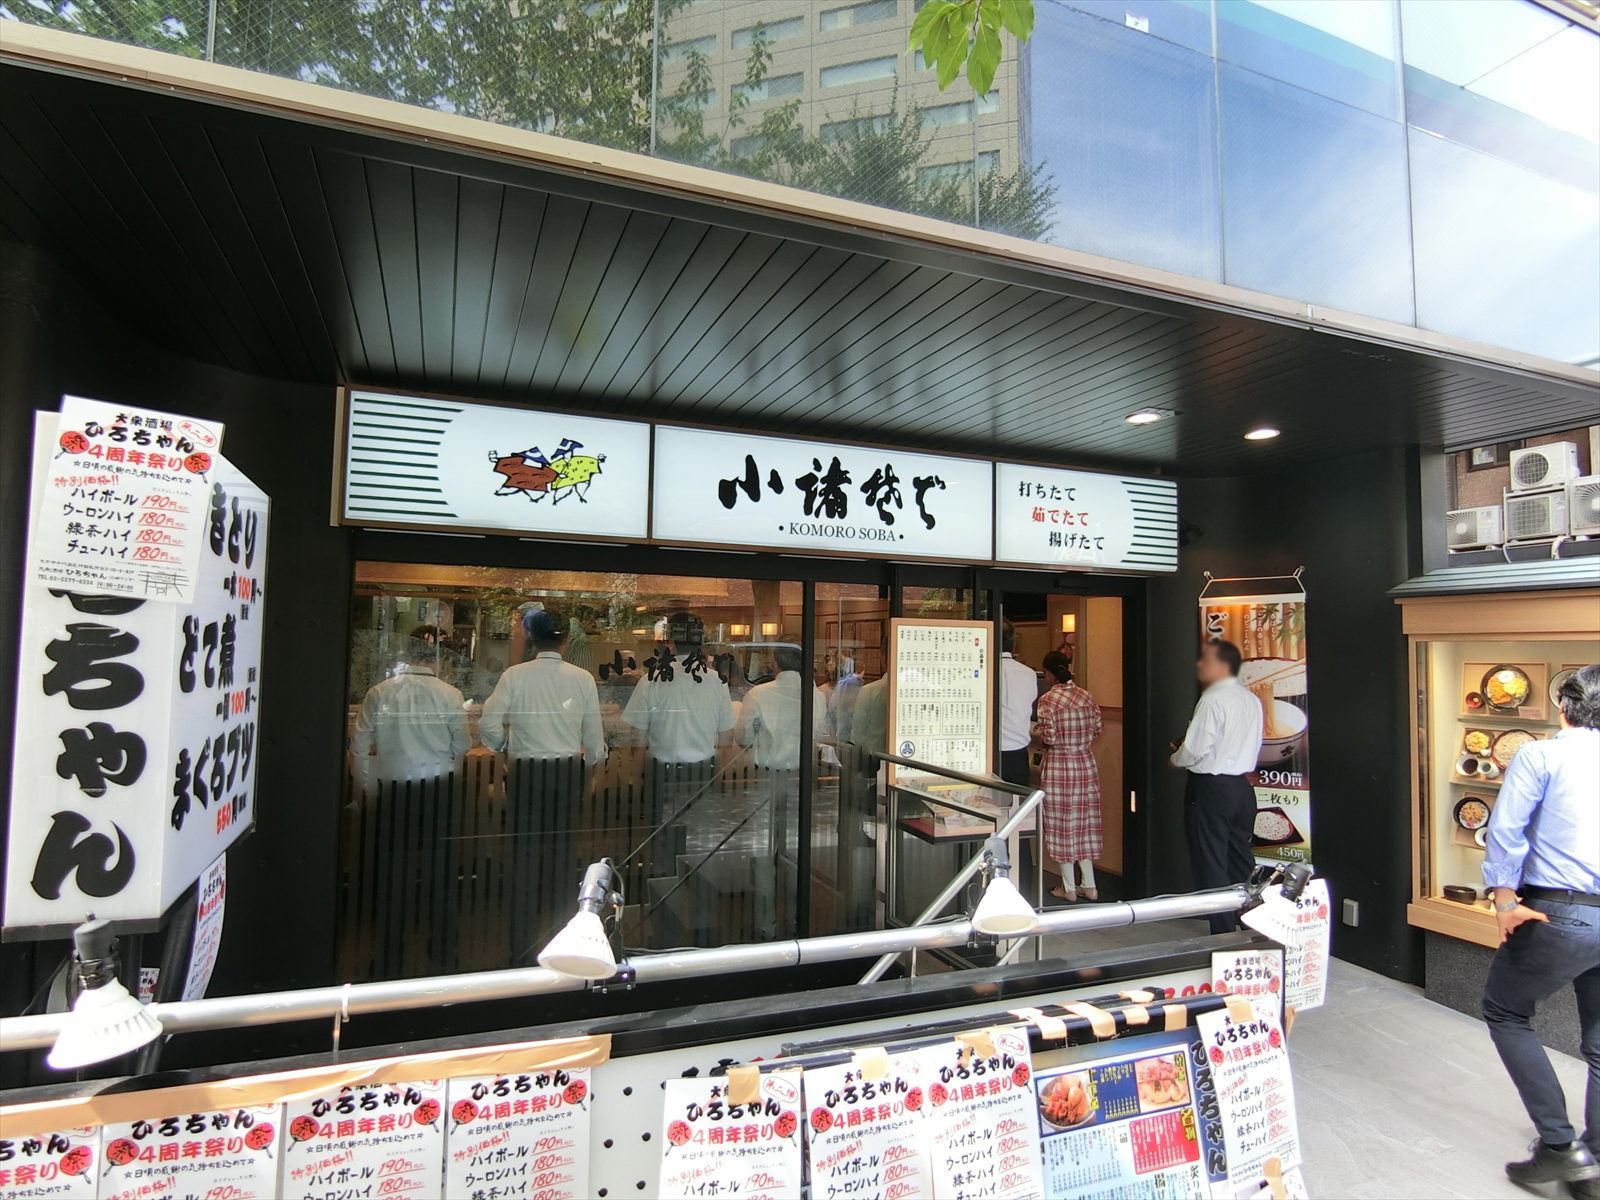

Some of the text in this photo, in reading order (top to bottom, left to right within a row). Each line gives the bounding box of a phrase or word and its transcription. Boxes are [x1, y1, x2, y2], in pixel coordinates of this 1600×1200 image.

[116, 413, 173, 431] 大衆酒場
[85, 422, 195, 454] ひろちゃん
[89, 445, 183, 471] 4周年祭り
[54, 476, 119, 487] 特別価格!!
[1019, 481, 1076, 501] 打ちたて
[71, 487, 138, 505] ハイボール
[142, 496, 176, 509] 190円
[63, 505, 173, 525] ウーロンハイ 180円
[1032, 507, 1088, 526] 茹でたて
[66, 523, 171, 543] 緑茶ハイ 180円
[789, 521, 896, 543] KOMORO SOBA
[1049, 532, 1105, 550] 揚げたて
[67, 540, 168, 560] チューハイ 180円
[180, 613, 237, 693] どて煮
[31, 590, 147, 900] ちゃん
[171, 721, 255, 831] まぐろブツ
[1259, 770, 1302, 786] 390円
[1258, 793, 1299, 806] 二枚もり
[1277, 847, 1304, 858] 450円
[1296, 897, 1320, 909] ちゃん
[1296, 913, 1318, 924] 年祭り
[1224, 967, 1272, 982] ひろちゃん
[1214, 1020, 1269, 1046] ひろちゃん
[1225, 1040, 1270, 1065] 4周年祭り
[939, 1053, 1016, 1083] ひろちゃん
[471, 1070, 571, 1101] ひろちゃん
[824, 1077, 909, 1109] ひろちゃん
[949, 1076, 1013, 1103] 4周年祭り
[1231, 1085, 1261, 1105] ハイボール
[312, 1087, 422, 1117] ひろちゃん
[478, 1093, 563, 1122] 4周年祭り
[687, 1098, 780, 1122] ひろちゃん
[1190, 1040, 1227, 1175] ひろちゃん
[1231, 1101, 1263, 1124] ウーロンハイ
[132, 1109, 255, 1140] ひろちゃん
[319, 1112, 413, 1140] 4周年祭り
[833, 1102, 904, 1129] 4周年祭り
[1237, 1116, 1265, 1138] 緑茶ハイ
[454, 1130, 511, 1162] 特別価格!!
[692, 1124, 774, 1145] 4周年祭り
[948, 1118, 1019, 1150] ハイボール 190円
[1240, 1132, 1267, 1155] チューハイ
[0, 1134, 70, 1161] ちゃん
[139, 1137, 244, 1164] 4周年祭り
[470, 1136, 563, 1167] ハイボール 190円
[816, 1140, 863, 1173] 特別価格!!
[946, 1146, 993, 1172] ウーロンハイ
[997, 1137, 1020, 1154] 180円
[0, 1162, 58, 1185] 年祭り
[291, 1150, 354, 1181] 特別価格!!
[309, 1158, 412, 1186] ハイボール 190円
[465, 1153, 563, 1188] ウーロンハイ 180円
[831, 1145, 908, 1178] ハイボール 190円
[952, 1155, 1022, 1188] 緑茶ハイ 180円
[378, 1177, 412, 1194] 180円
[532, 1171, 563, 1187] 180円
[683, 1173, 774, 1196] ハイボール 190円
[828, 1164, 909, 1200] ウーロンハイ 180円
[999, 1172, 1023, 1189] 180円
